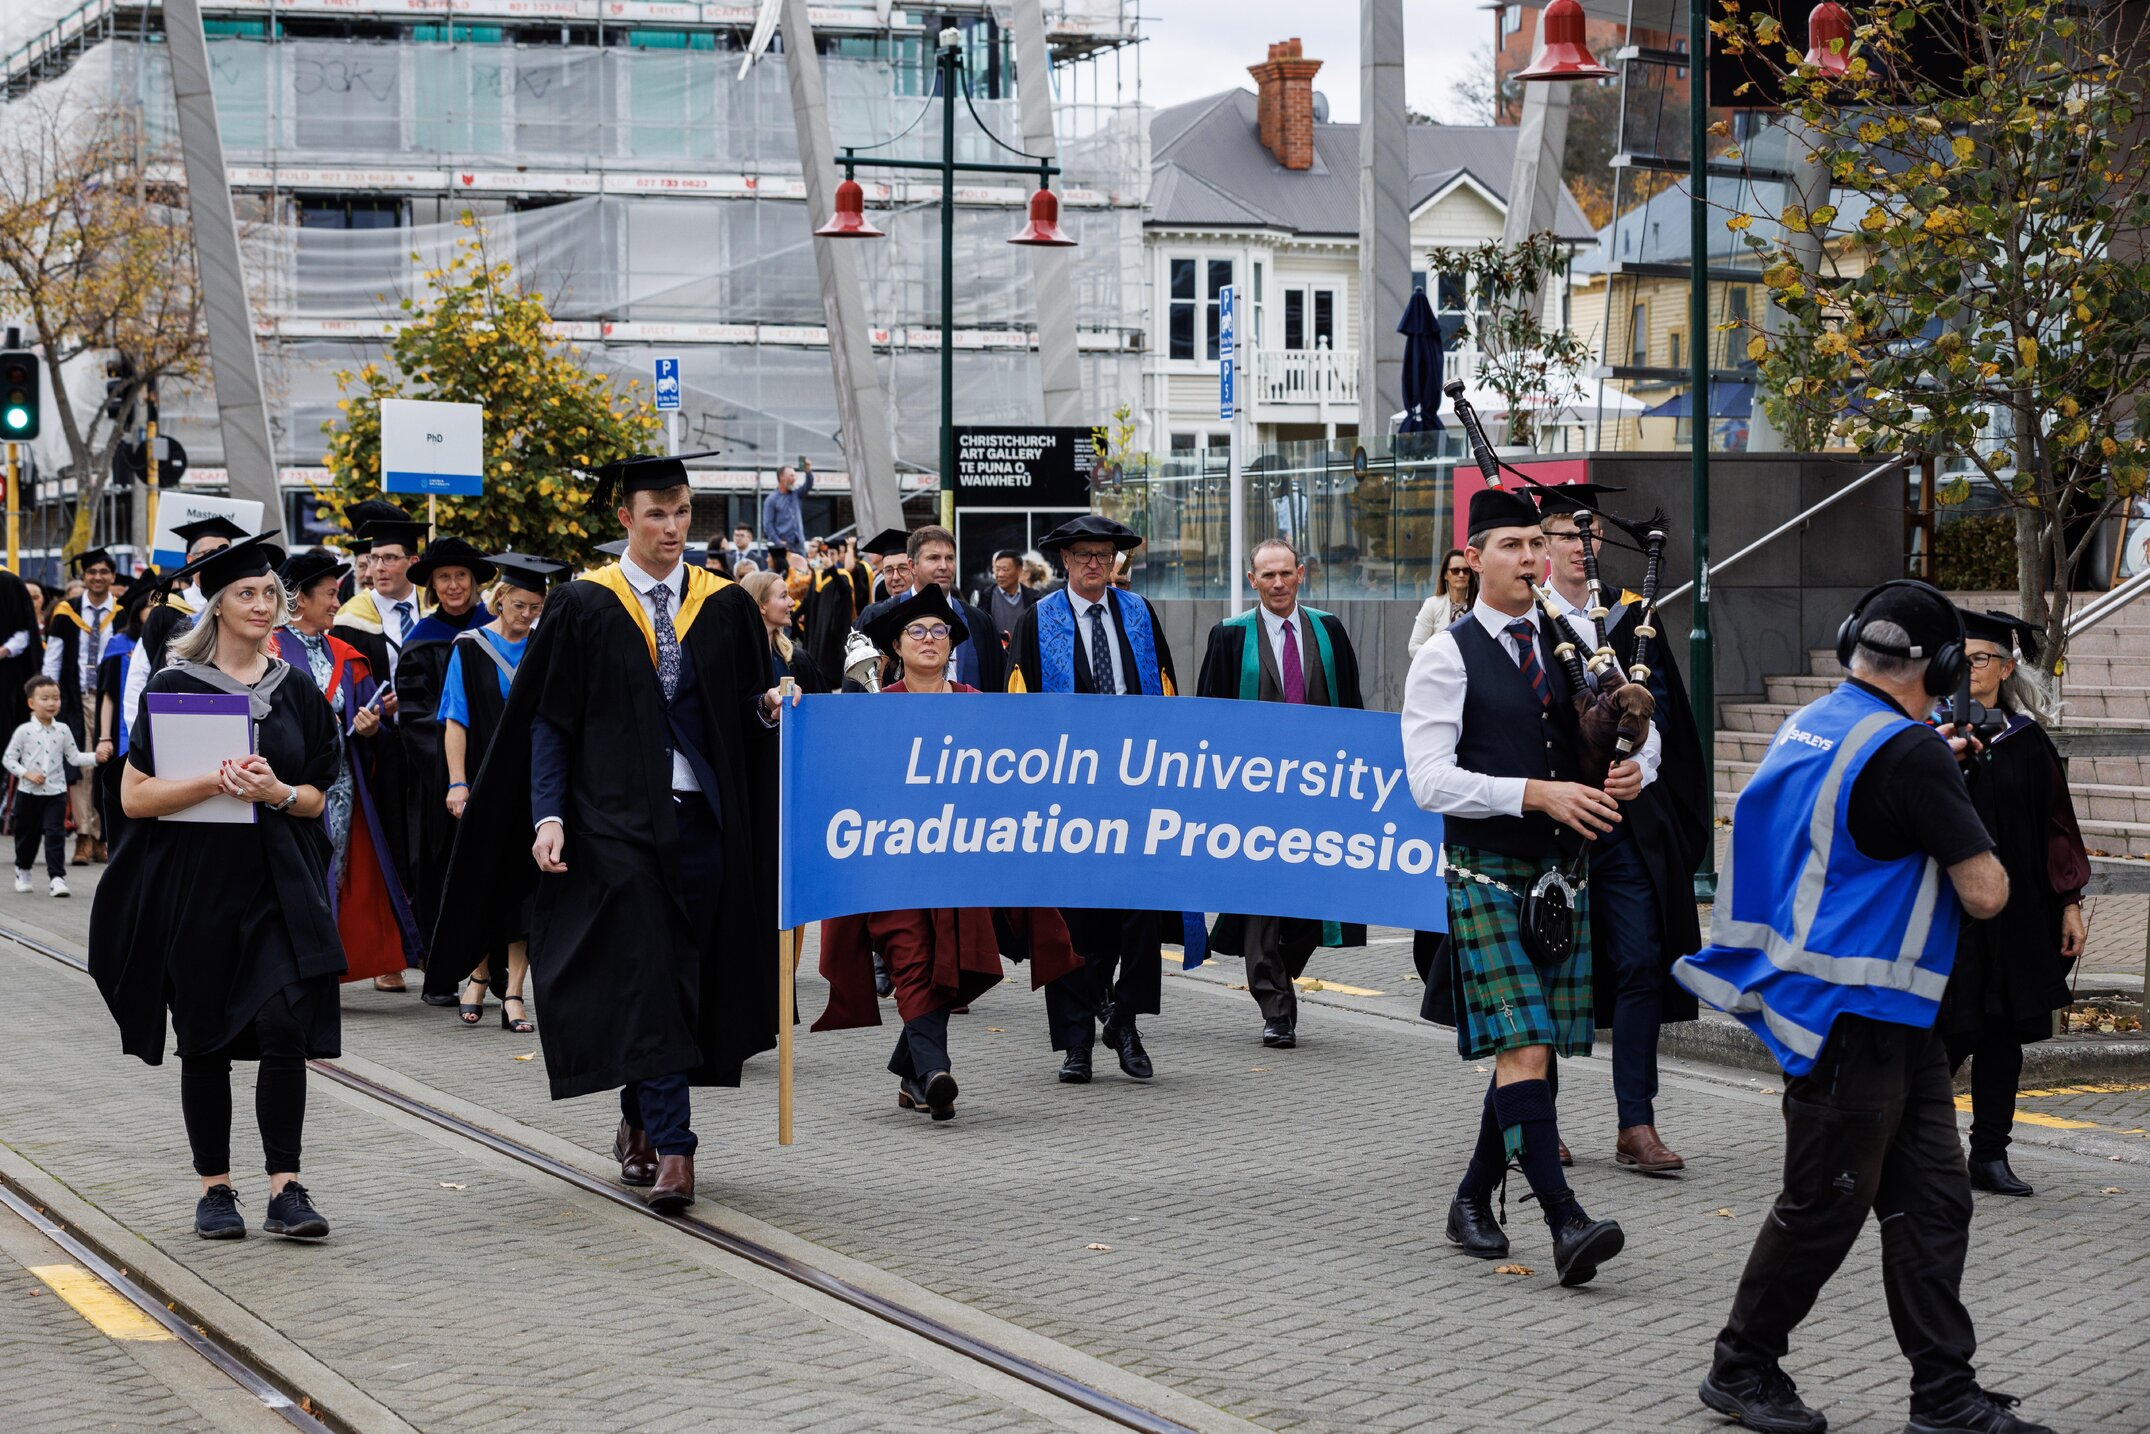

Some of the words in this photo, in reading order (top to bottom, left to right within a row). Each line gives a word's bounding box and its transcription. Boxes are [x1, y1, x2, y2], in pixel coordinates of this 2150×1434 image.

[662, 360, 672, 376] P
[427, 433, 443, 443] PhD
[959, 435, 1056, 447] CHRISTCHURCH
[959, 448, 985, 460] ART
[987, 448, 1043, 460] GALLERY
[959, 462, 975, 473] TE
[977, 462, 1013, 473] PUNA
[1015, 462, 1026, 473] O
[959, 472, 1032, 487] WAIWHETŪ
[905, 735, 1099, 786] Lincoln
[1119, 738, 1403, 812] University
[826, 803, 1129, 860] Graduation
